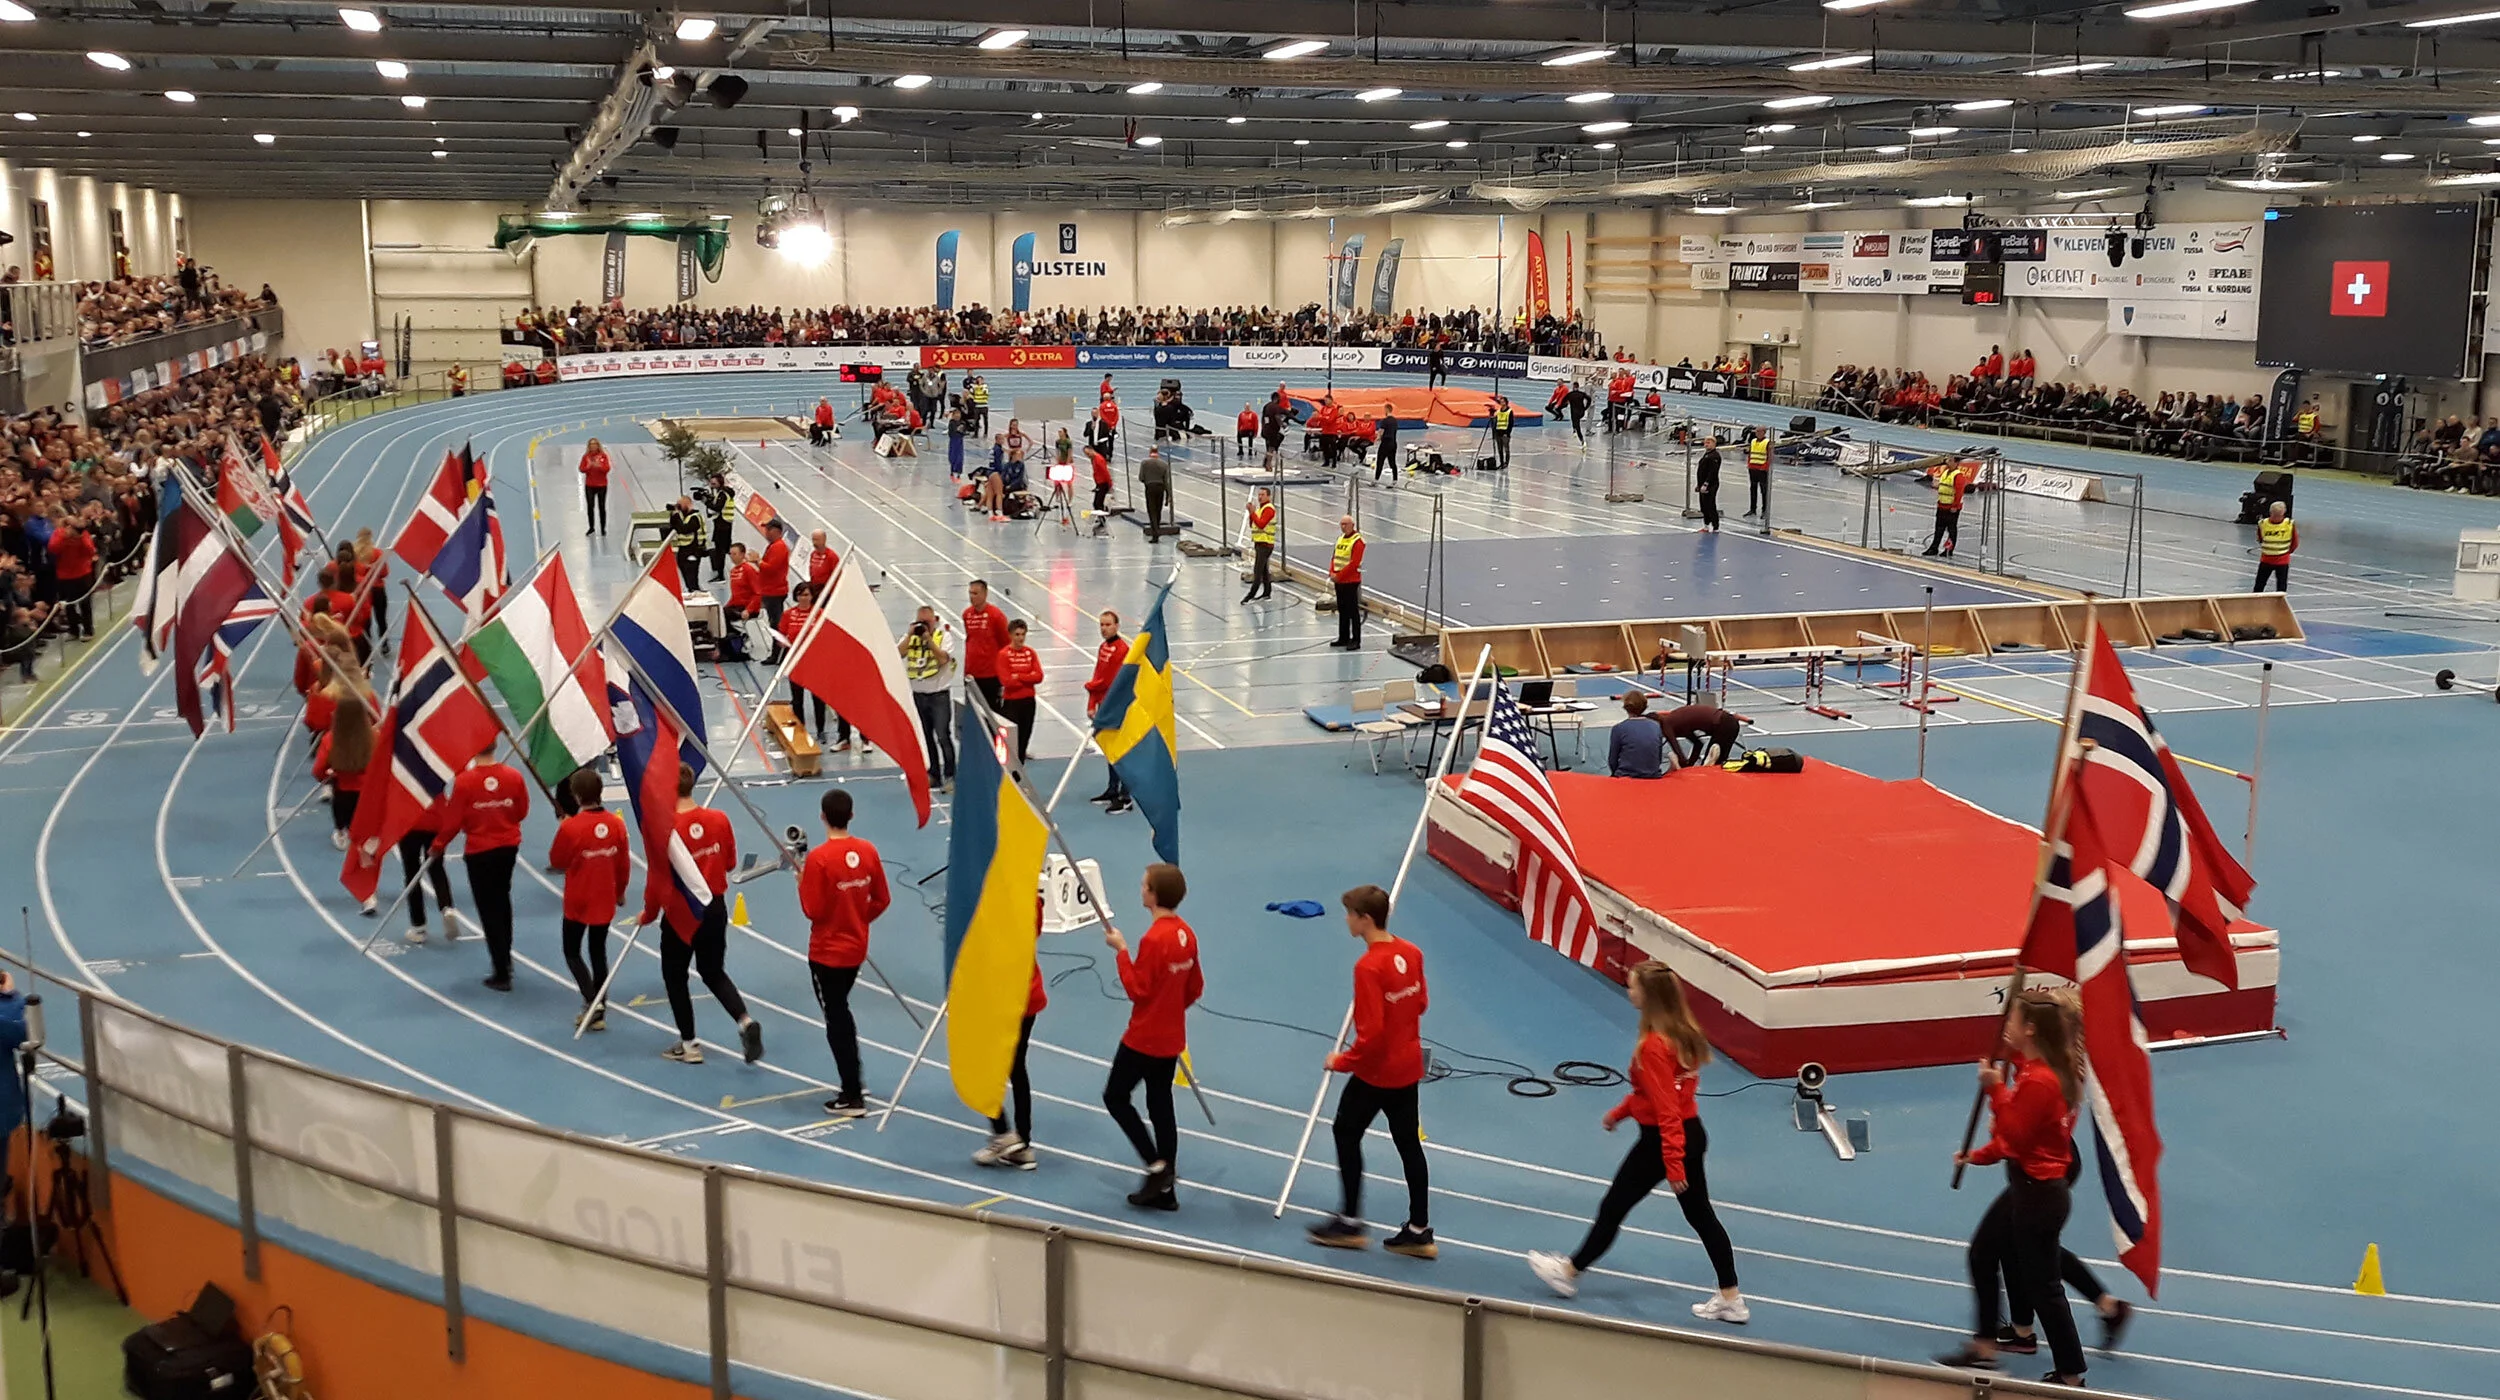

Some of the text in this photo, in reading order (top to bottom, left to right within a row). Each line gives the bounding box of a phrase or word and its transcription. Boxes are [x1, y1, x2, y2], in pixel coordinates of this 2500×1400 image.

[2064, 238, 2105, 251] KLEVEN
[1032, 262, 1106, 276] ULSTEIN
[1731, 266, 1770, 280] TRIMTEX
[2214, 269, 2248, 279] PEAB
[1848, 275, 1882, 287] Nordea
[2216, 285, 2252, 294] NORDANG
[952, 352, 985, 361] EXTRA
[1029, 352, 1062, 361] EXTRA
[2482, 553, 2499, 567] NR
[1077, 884, 1088, 904] 6
